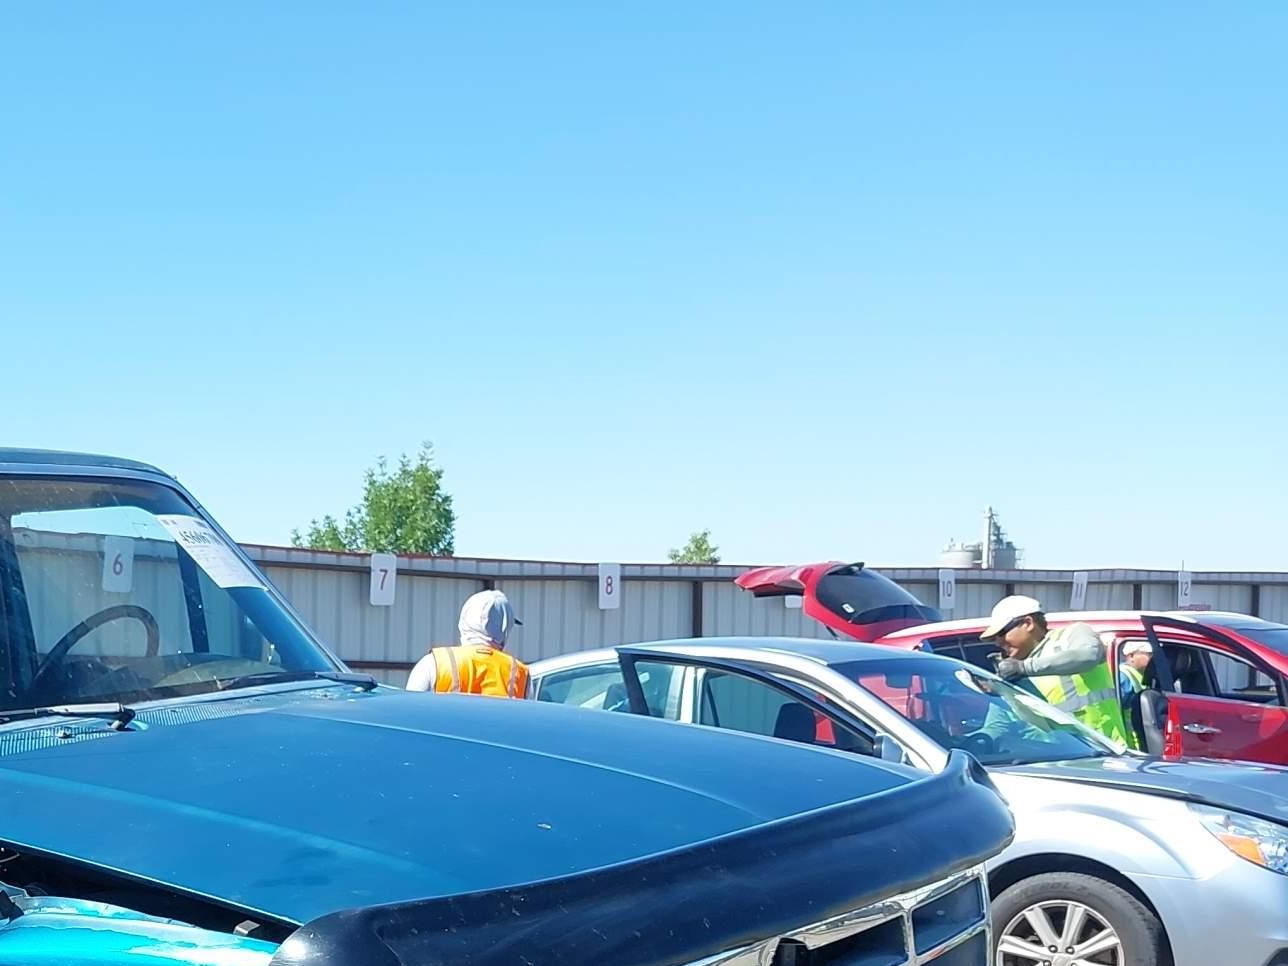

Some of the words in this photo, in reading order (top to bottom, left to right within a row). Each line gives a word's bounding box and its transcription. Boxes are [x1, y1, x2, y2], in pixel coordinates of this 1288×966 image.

[112, 552, 123, 576] 6
[379, 568, 389, 591] 7
[605, 575, 613, 595] 8
[942, 580, 953, 598] 10
[1180, 581, 1189, 597] 12
